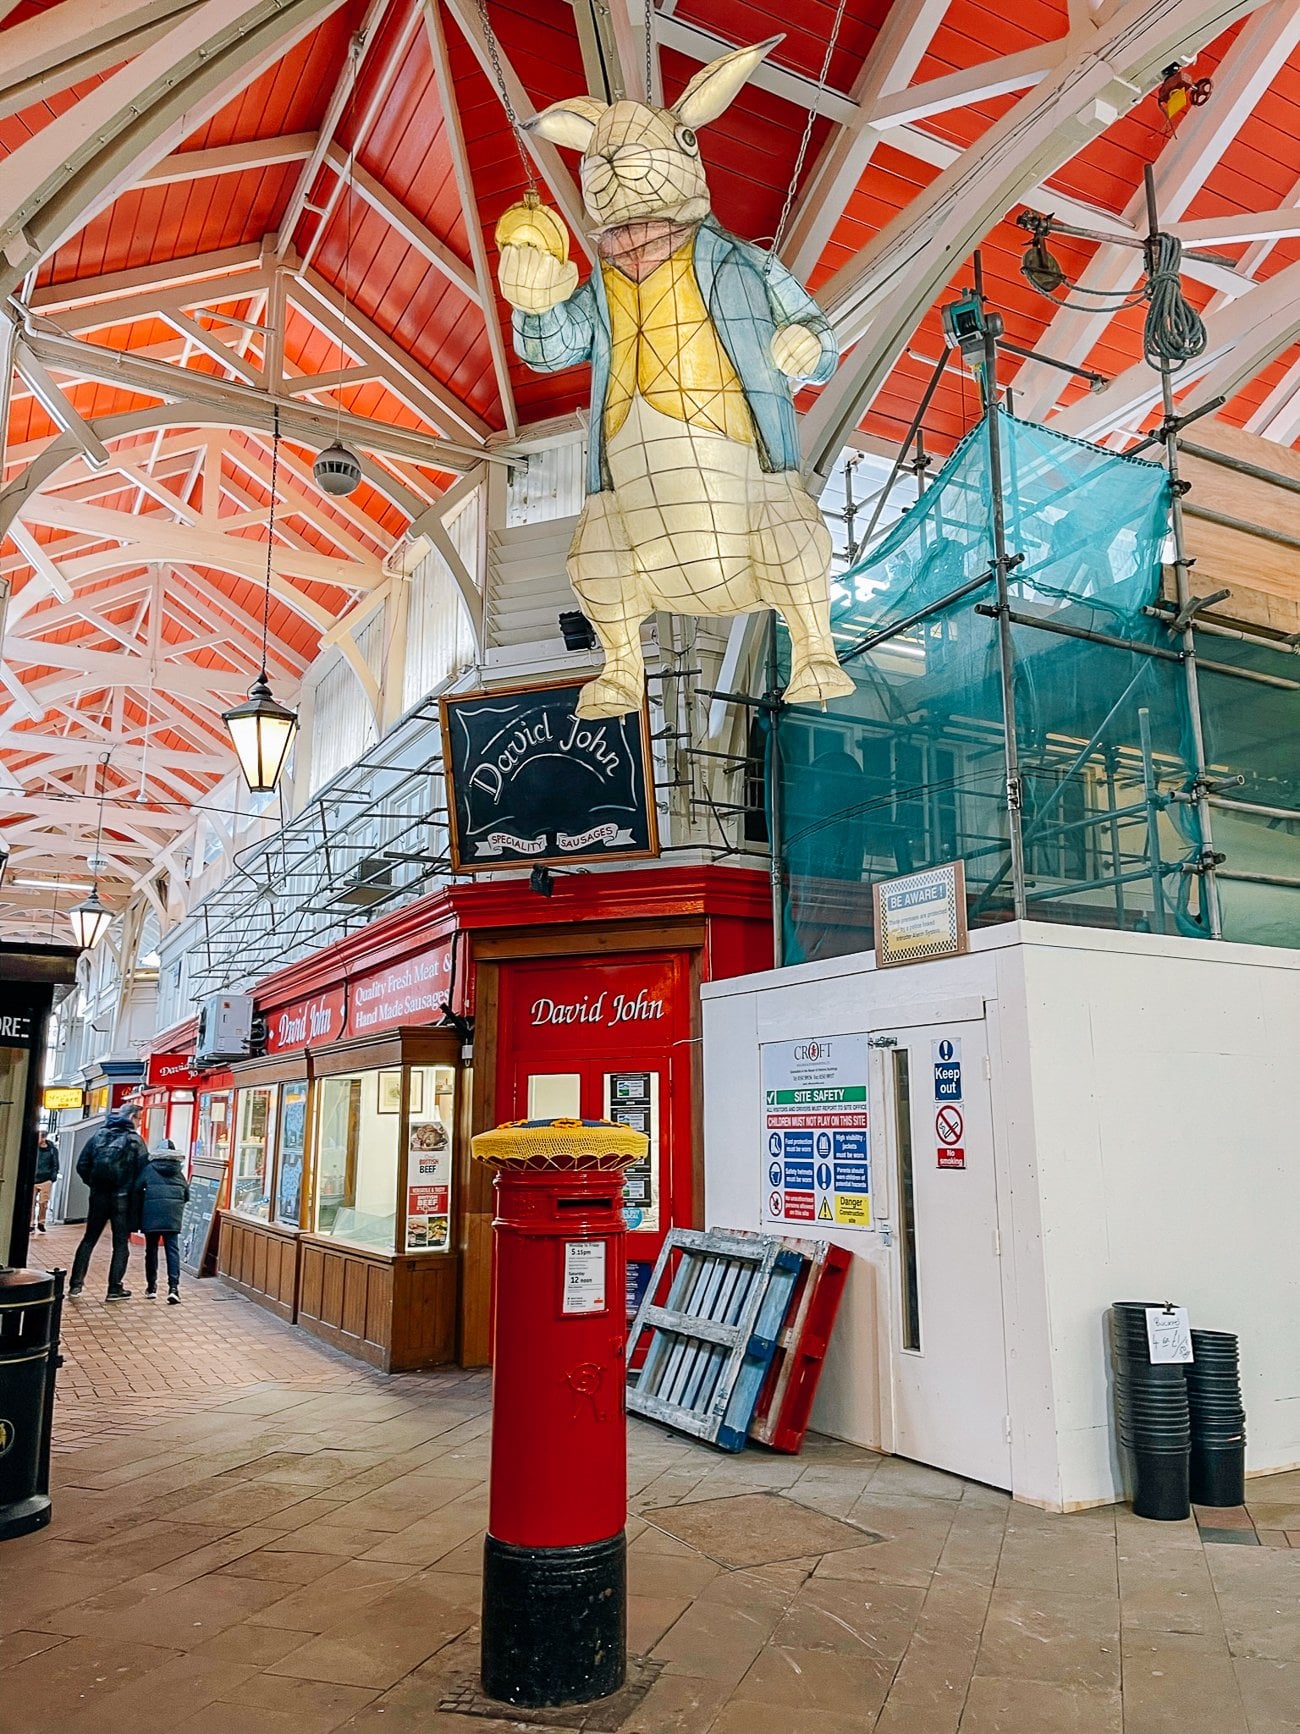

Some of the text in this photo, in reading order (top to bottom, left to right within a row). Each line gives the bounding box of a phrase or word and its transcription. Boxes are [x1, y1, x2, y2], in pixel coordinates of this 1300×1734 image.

[469, 712, 621, 805] David John
[492, 826, 613, 852] SPECIALITY SAUSAGES
[891, 896, 903, 908] BE
[904, 887, 938, 906] AWARE
[355, 953, 452, 1006] Quality Fresh Meat &
[356, 989, 450, 1028] Hand Made Sausages
[531, 988, 665, 1027] David John
[0, 1015, 21, 1038] RE
[278, 995, 332, 1047] David John
[794, 1042, 832, 1061] CROFT
[935, 1068, 960, 1082] Keep
[794, 1089, 844, 1102] SITE SAFETY
[940, 1081, 957, 1094] out
[768, 1115, 866, 1126] CHILDREN MUST NOT PLAY ON THIS SITE
[836, 1134, 863, 1142] High visibility
[940, 1157, 962, 1165] smoking
[420, 1165, 437, 1174] BEEF
[840, 1197, 862, 1209] Danger
[570, 1276, 579, 1284] 12
